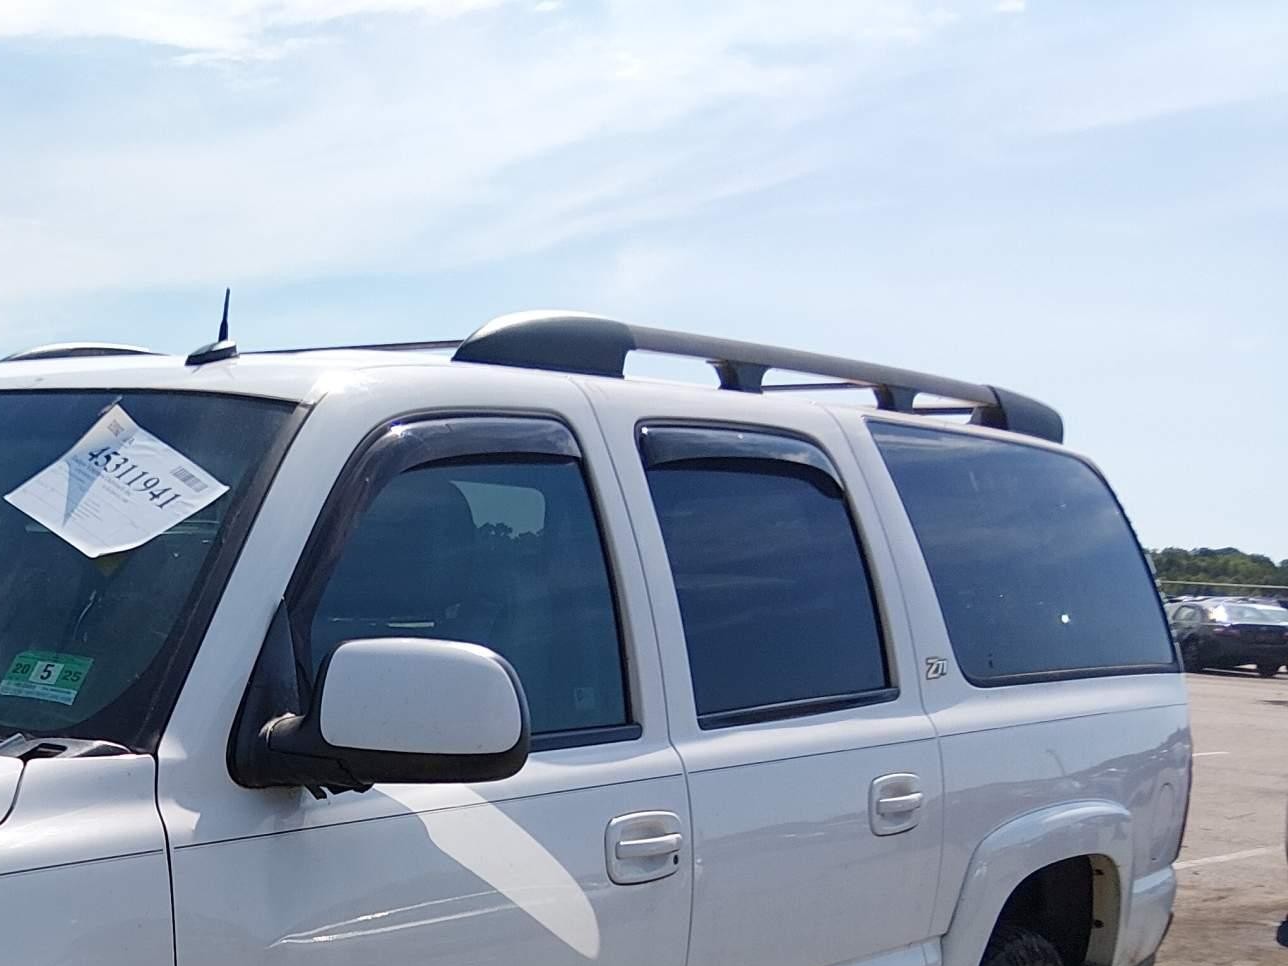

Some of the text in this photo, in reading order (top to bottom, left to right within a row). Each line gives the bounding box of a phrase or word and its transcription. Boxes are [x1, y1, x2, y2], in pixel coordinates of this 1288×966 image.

[88, 446, 181, 509] 45311941
[12, 663, 82, 682] 20 5 25
